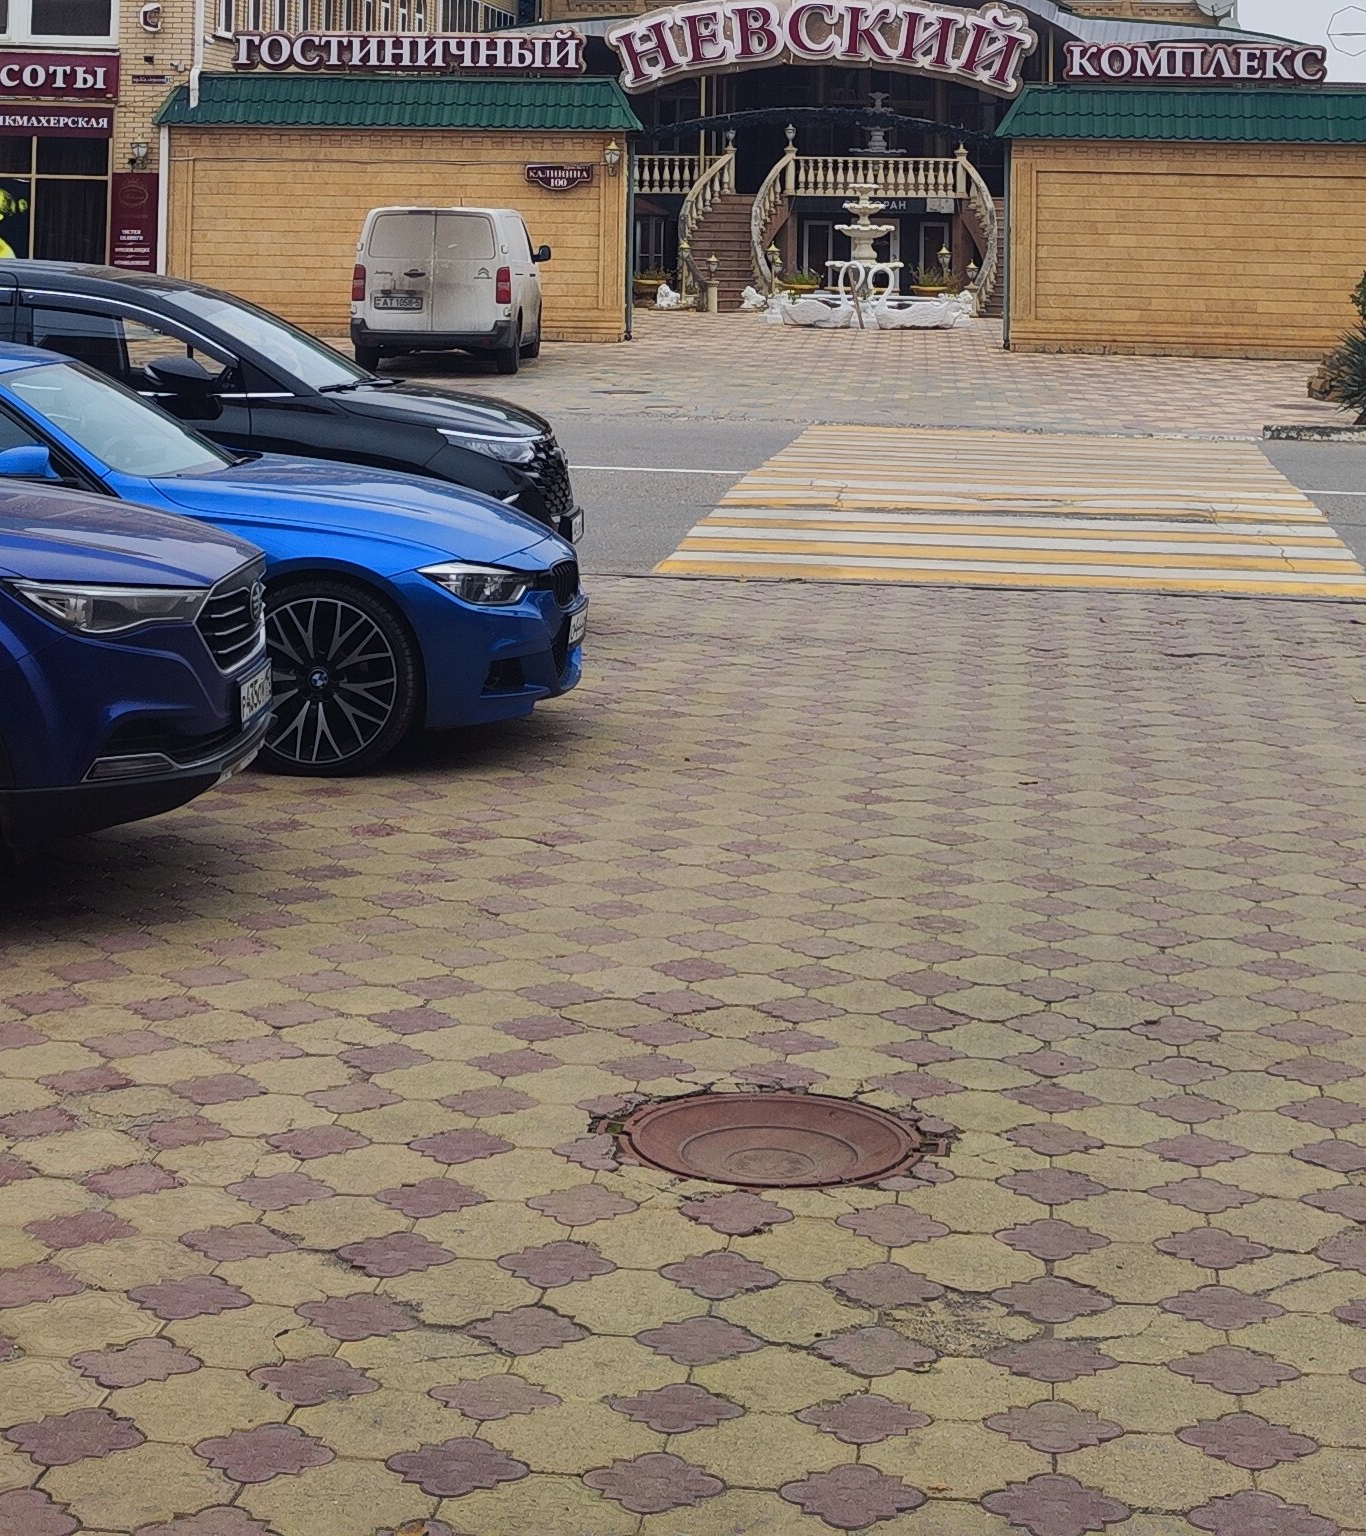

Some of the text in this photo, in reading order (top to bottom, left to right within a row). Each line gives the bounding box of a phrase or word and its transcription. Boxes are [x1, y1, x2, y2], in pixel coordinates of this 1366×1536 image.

[236, 31, 580, 69] ГОСТИНИЧНЫЙ
[614, 2, 1027, 89] НЕВСКИЙ
[1069, 45, 1323, 80] КОМПЛЕКС
[529, 169, 588, 178] КАЛИНИНА
[550, 178, 568, 187] 100
